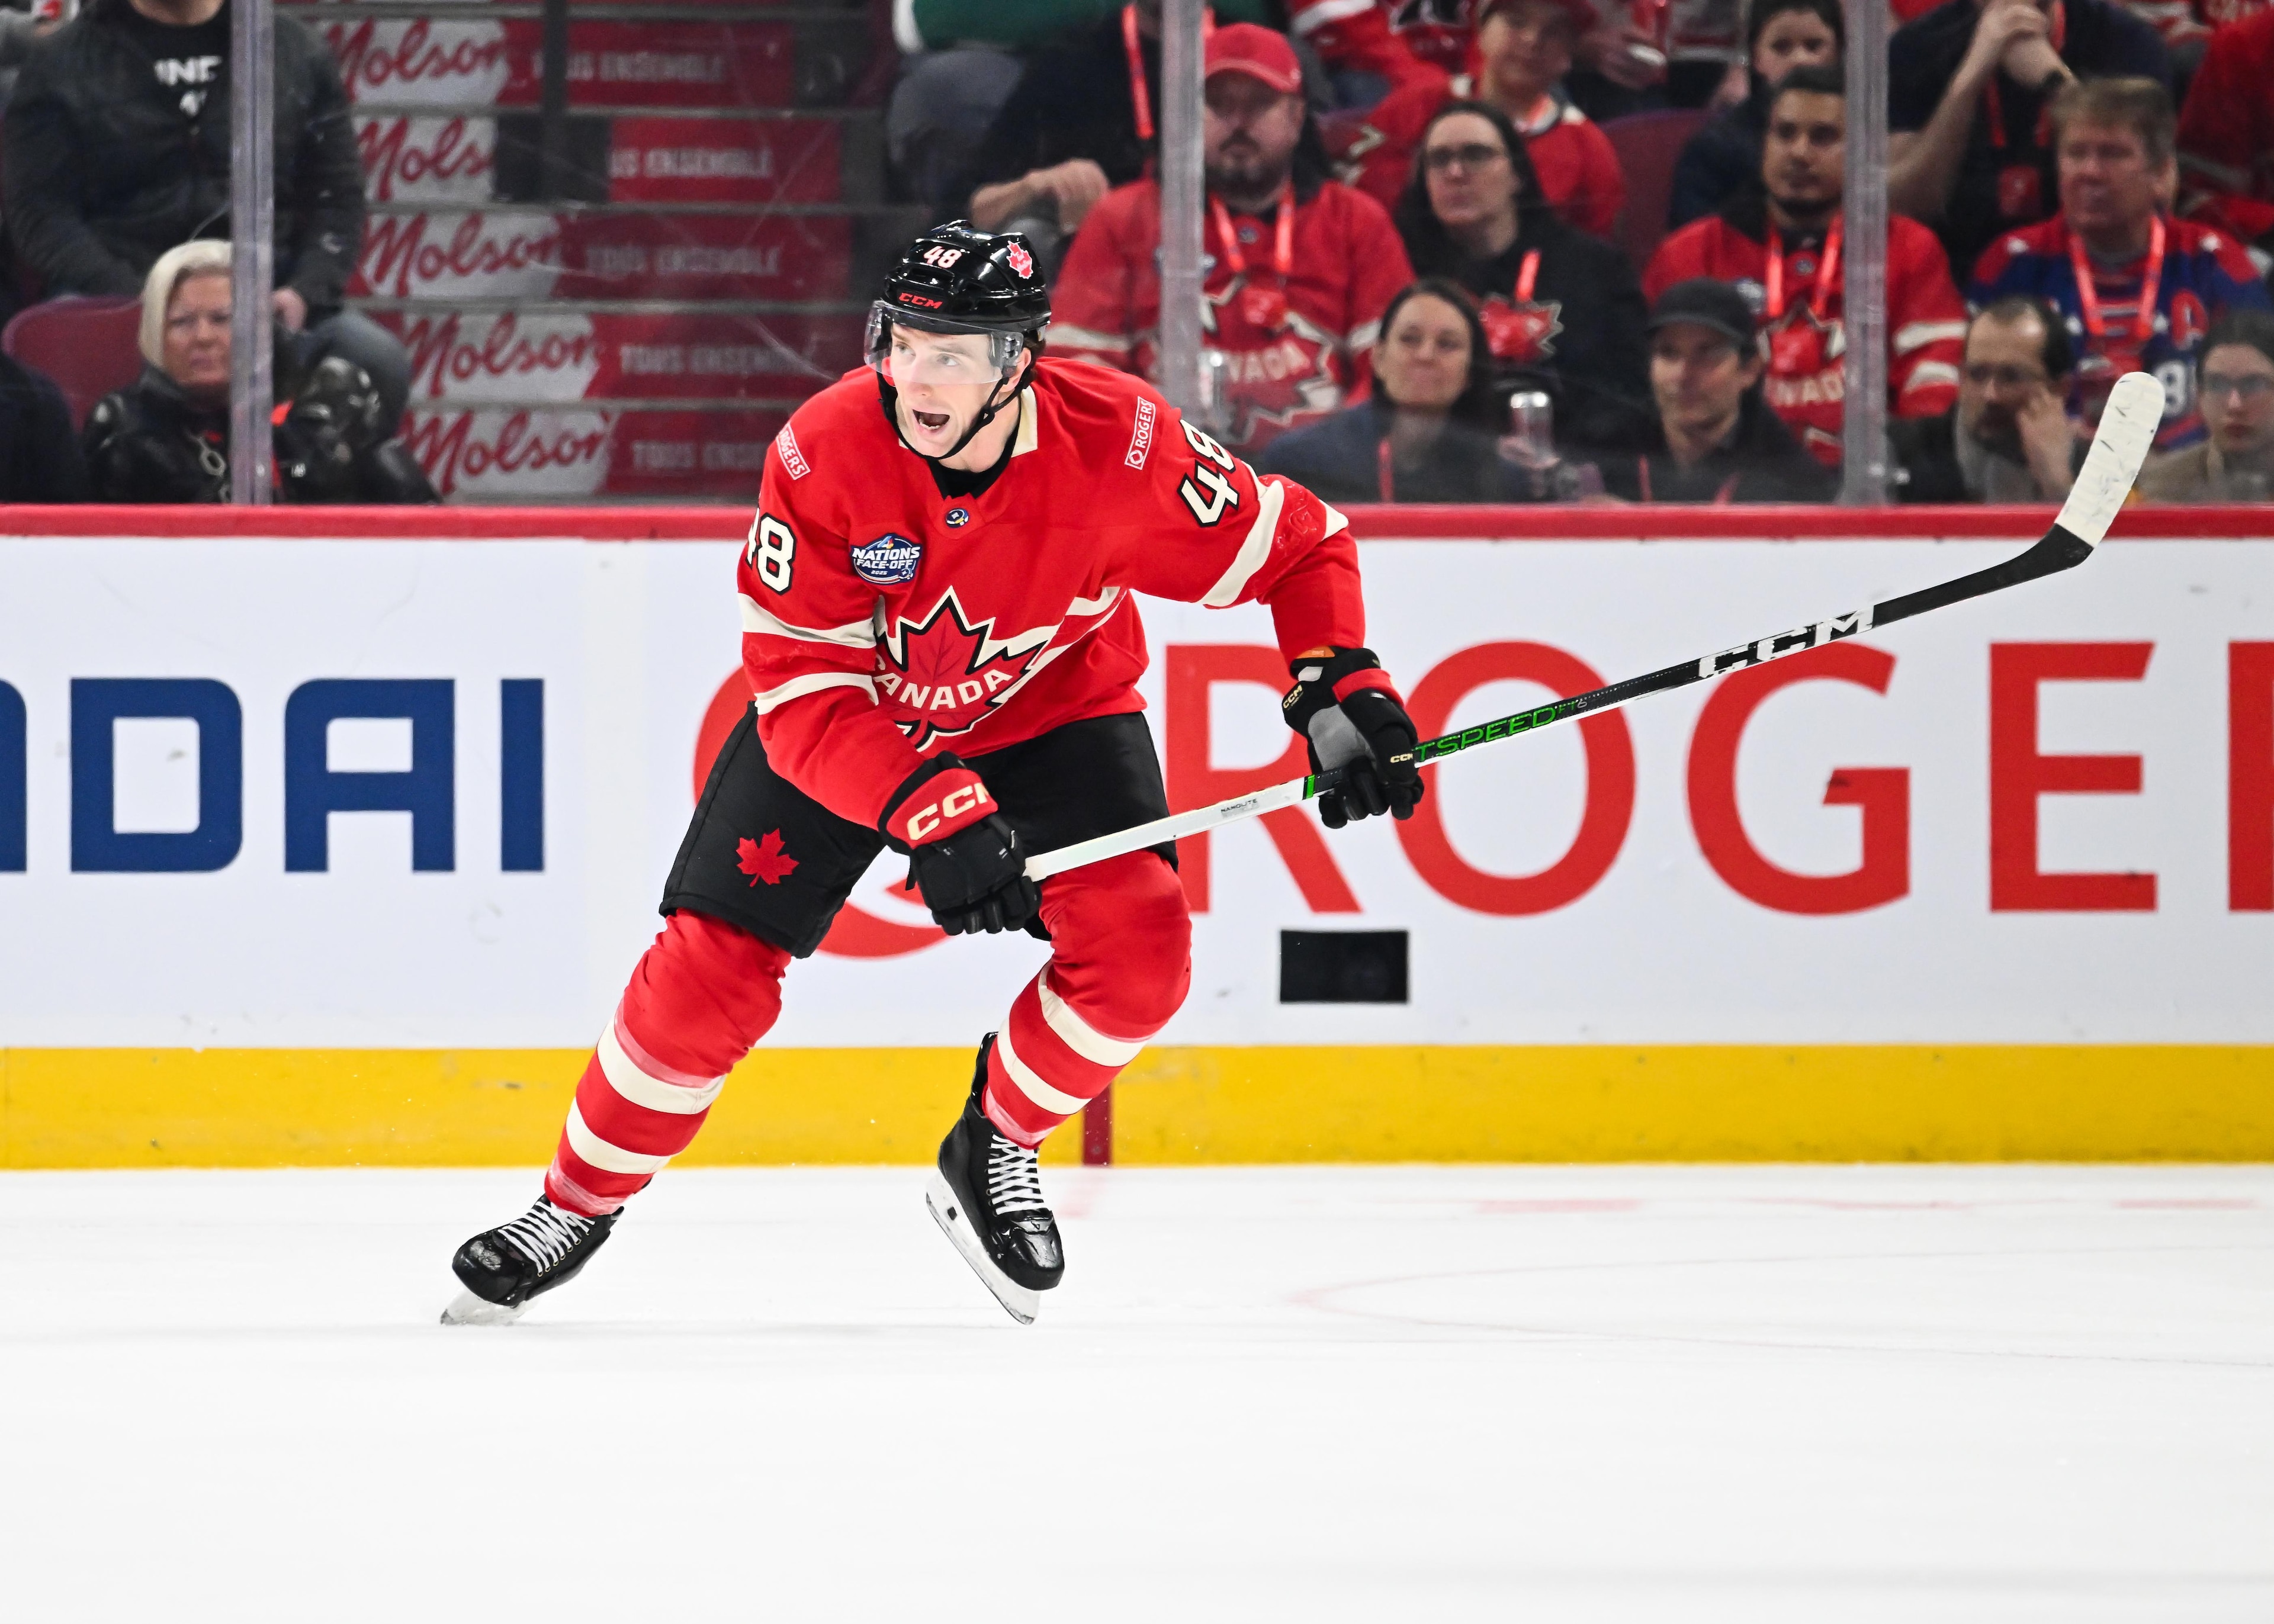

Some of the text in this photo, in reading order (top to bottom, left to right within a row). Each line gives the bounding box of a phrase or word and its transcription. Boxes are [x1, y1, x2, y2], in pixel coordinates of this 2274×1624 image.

[327, 18, 505, 103] Molson
[357, 117, 496, 202] Mols
[360, 213, 561, 296] Molson
[924, 245, 962, 269] 48
[898, 292, 943, 309] CCM
[407, 313, 597, 397] Molson
[411, 410, 604, 495] Molson
[779, 430, 805, 475] ROGERS
[1135, 400, 1152, 449] ROGERS
[1177, 419, 1240, 528] 48
[852, 546, 921, 561] NATIONS
[856, 558, 914, 570] FACE-OFF
[1698, 604, 1874, 679] CCM
[1283, 684, 1303, 709] CCM
[1412, 707, 1556, 763] TSPEED
[0, 677, 545, 873] DAI
